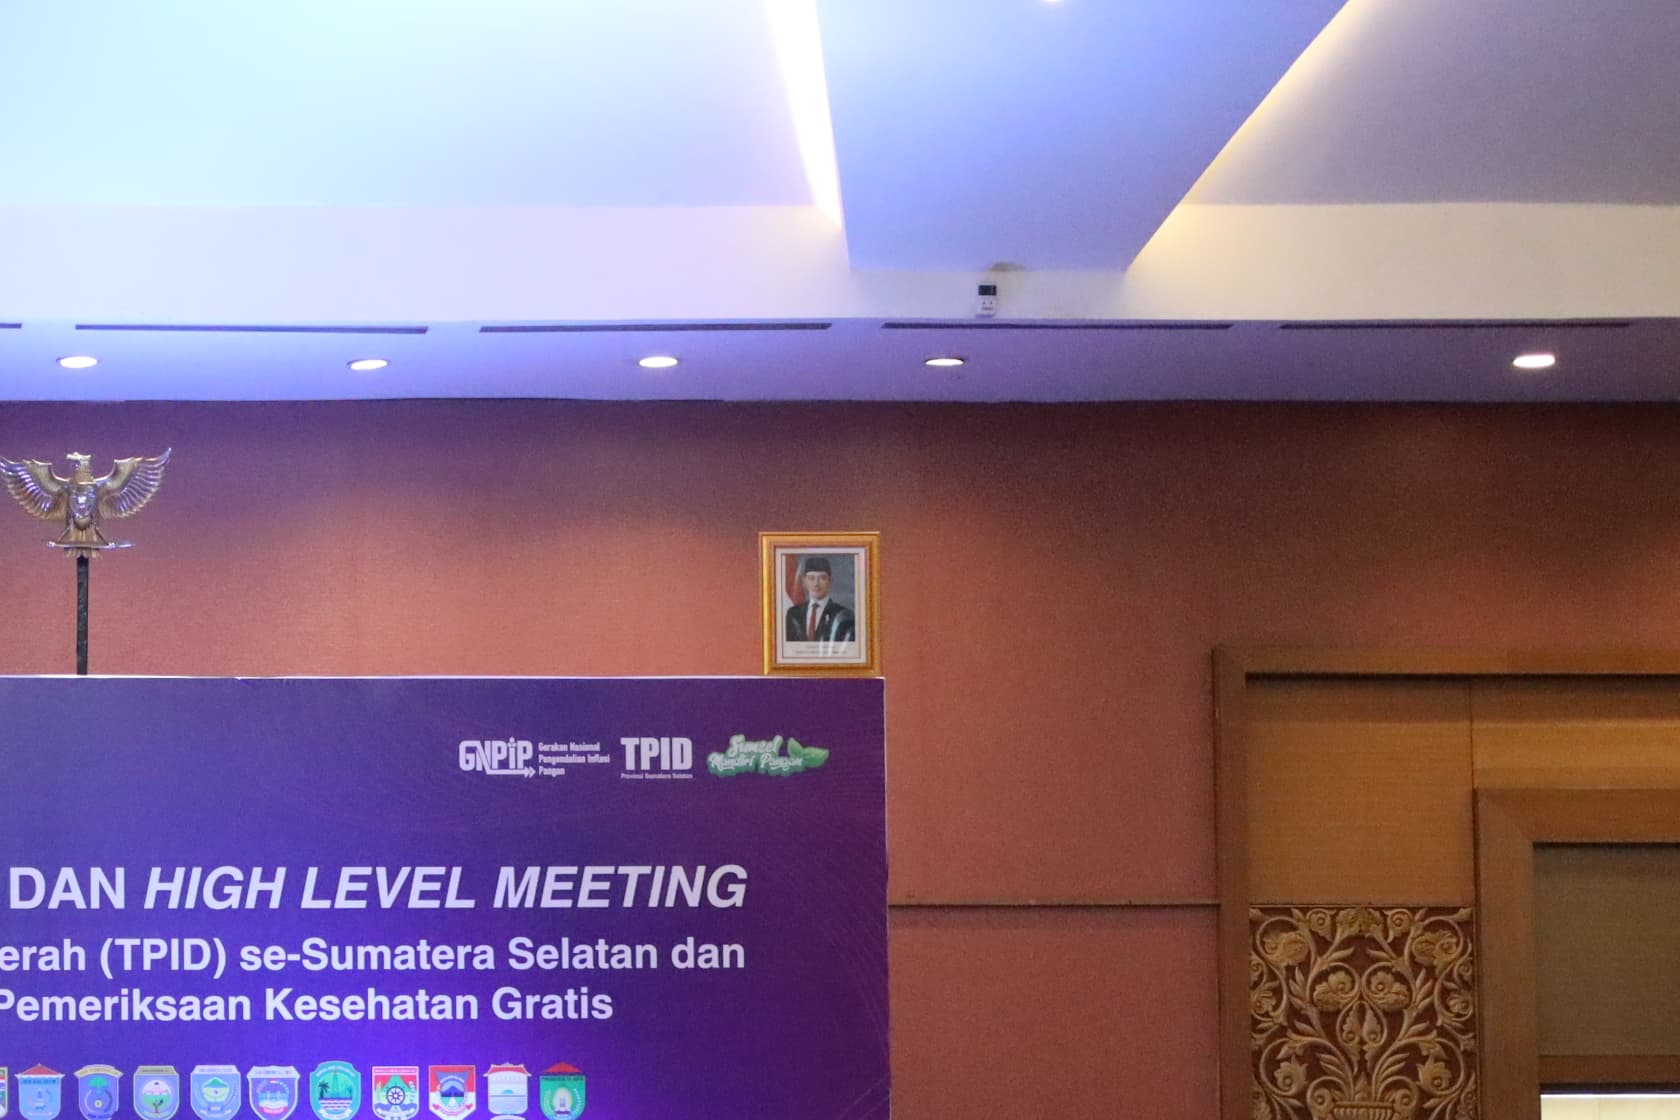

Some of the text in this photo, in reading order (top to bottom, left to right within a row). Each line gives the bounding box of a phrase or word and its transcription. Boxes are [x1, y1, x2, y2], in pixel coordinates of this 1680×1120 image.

[538, 742, 601, 752] Gerakan Nasional
[620, 737, 693, 770] TPID
[538, 766, 566, 777] Pangan
[9, 866, 125, 910] DAN
[143, 865, 287, 910] HIGH
[300, 866, 475, 909] LEVEL
[493, 864, 747, 908] MEETING
[100, 936, 227, 979] (TPID)
[239, 937, 496, 972] se-Sumatera
[508, 936, 658, 971] Selatan
[671, 936, 745, 969] dan
[265, 987, 478, 1021] Kesehatan
[492, 986, 613, 1020] Gratis
